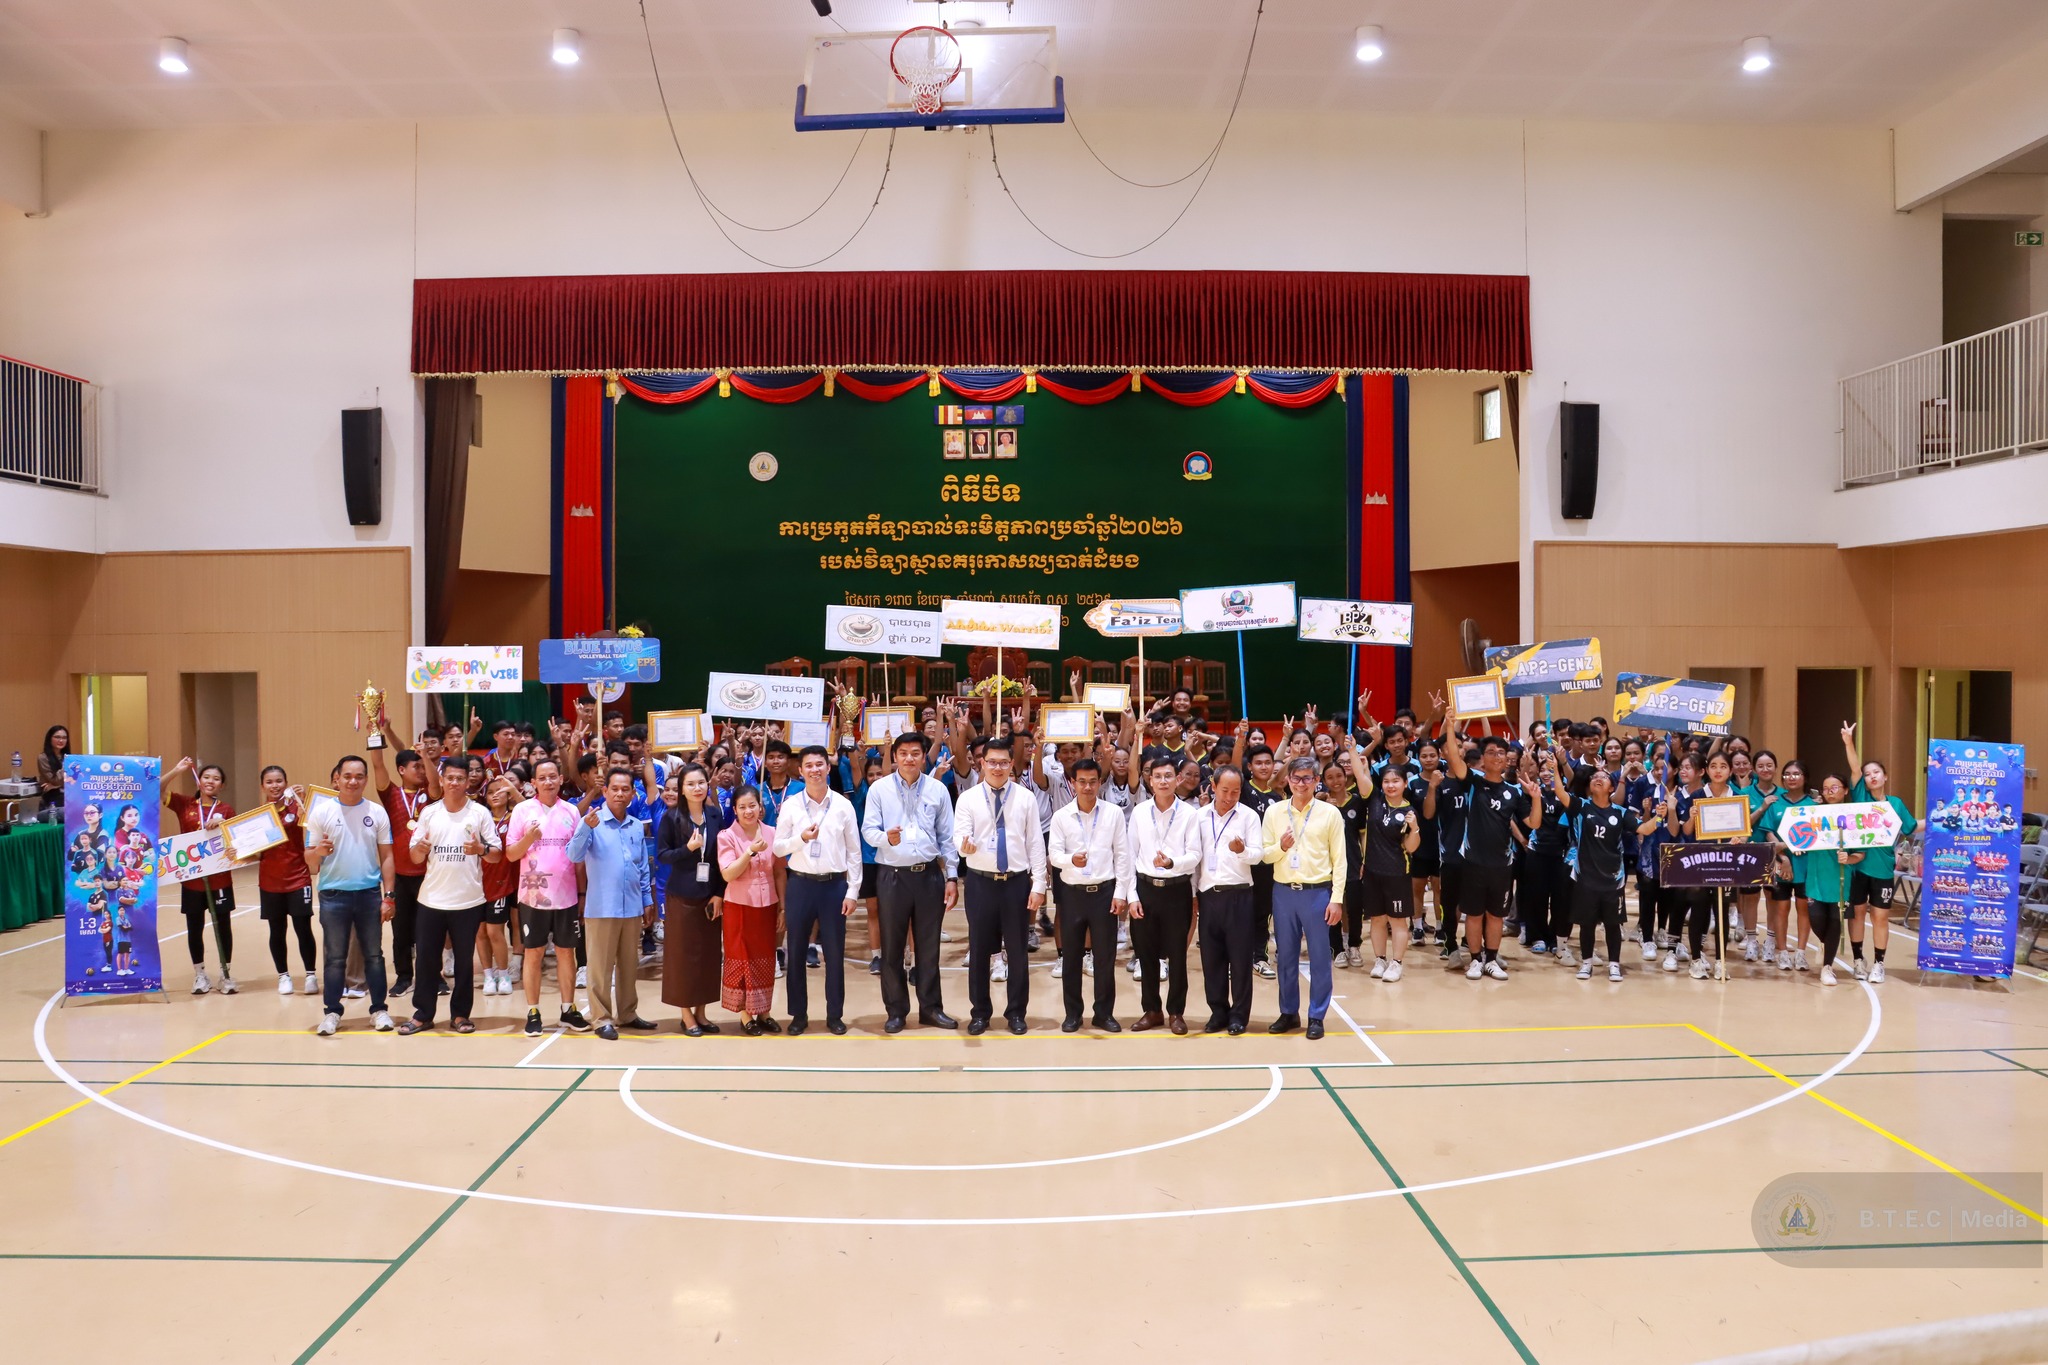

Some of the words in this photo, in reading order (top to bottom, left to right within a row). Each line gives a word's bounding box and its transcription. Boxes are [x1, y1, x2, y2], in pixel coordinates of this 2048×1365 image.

[940, 473, 1021, 503] ពិធីបិទ
[1334, 624, 1377, 637] EMPEROR
[563, 640, 600, 655] BLUE
[602, 640, 643, 654] TWOS
[910, 636, 932, 645] DP2
[506, 647, 521, 658] FP2
[425, 659, 488, 676] VICTORY
[490, 667, 519, 680] VIBE
[637, 657, 657, 668] EP2
[1516, 656, 1594, 677] AP2-GENZ
[1559, 677, 1602, 692] VOLLEYBALL
[792, 701, 814, 710] DP2
[1645, 692, 1726, 717] AP2-GENZ
[1686, 720, 1729, 736] VOLLEYBALL
[1454, 795, 1465, 809] 17
[1490, 798, 1502, 811] 99
[1593, 824, 1607, 839] 12
[1859, 832, 1876, 846] 17
[157, 835, 226, 878] BLOCKE
[445, 854, 467, 862] BETTER
[1679, 851, 1734, 870] BIOHOLIC
[1736, 853, 1758, 866] 4TH
[79, 917, 97, 930] 1-3
